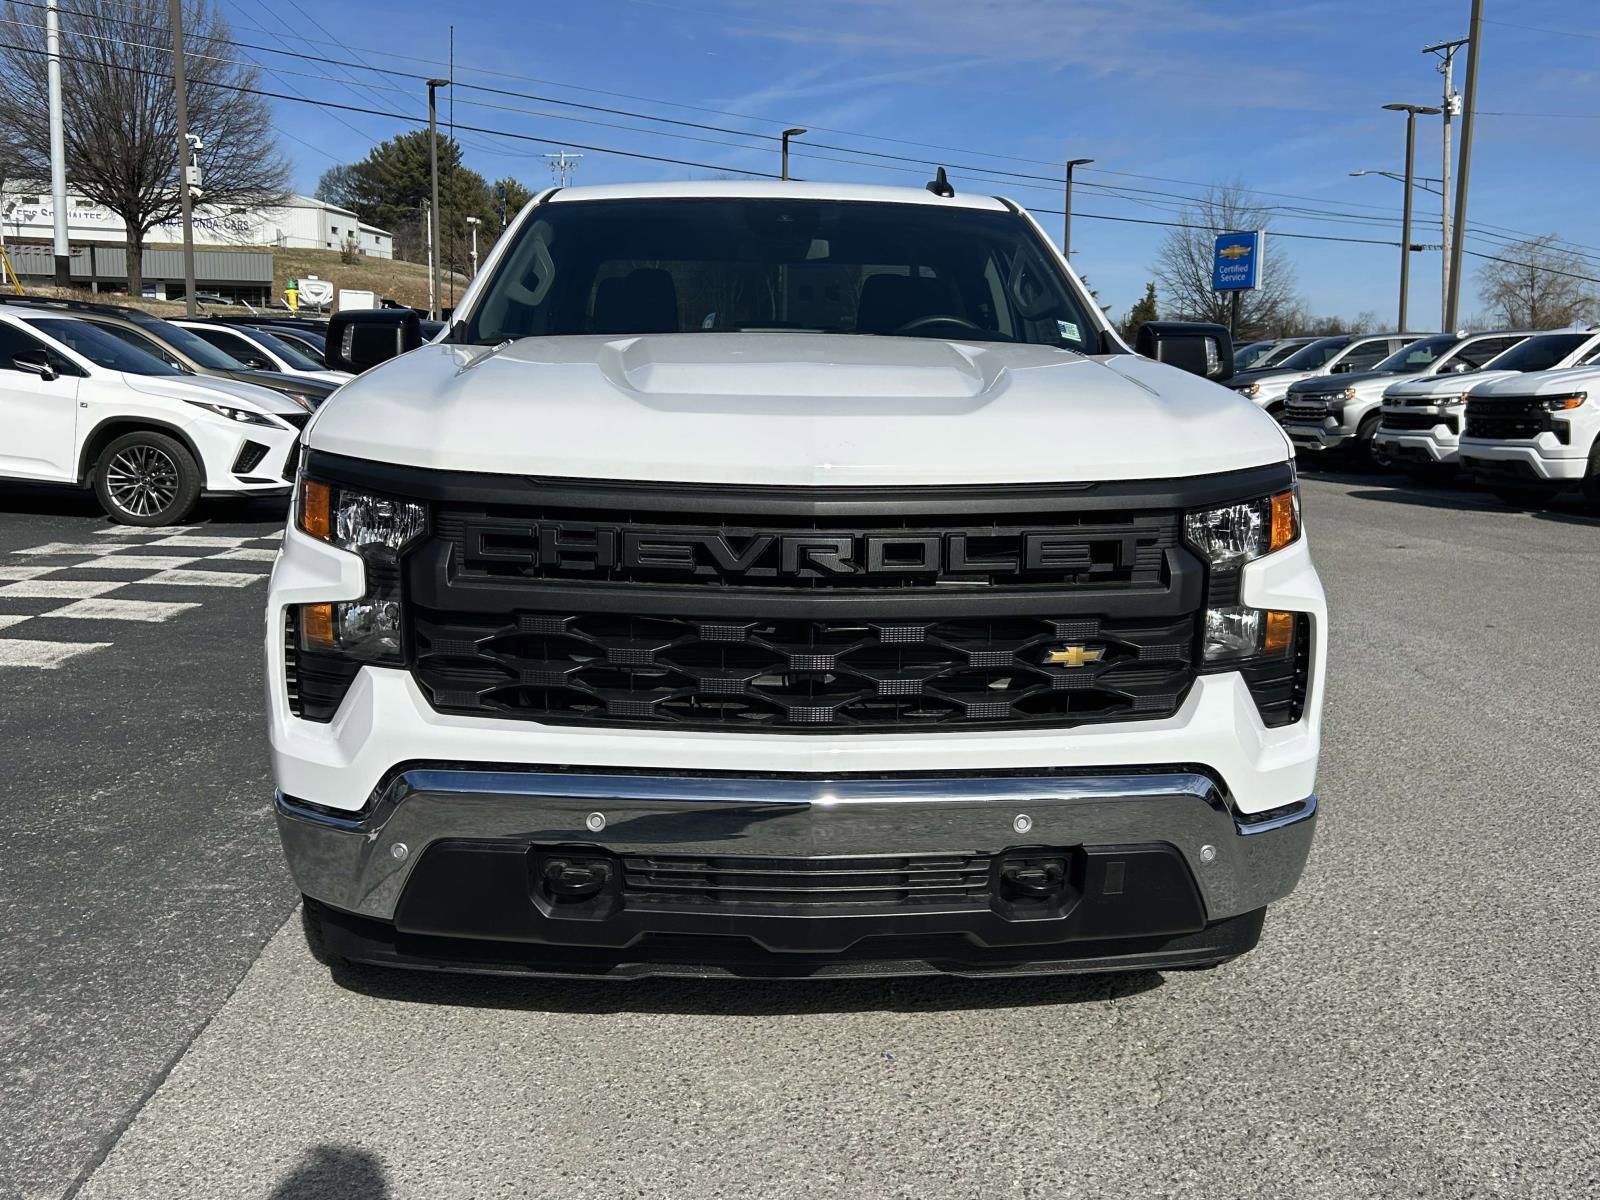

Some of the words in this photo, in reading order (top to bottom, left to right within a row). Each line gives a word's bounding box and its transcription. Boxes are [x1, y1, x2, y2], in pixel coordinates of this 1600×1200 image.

[223, 217, 249, 231] CARS
[1219, 264, 1249, 274] Certified
[1221, 274, 1246, 282] Service
[463, 521, 1160, 576] CHEVROLET
